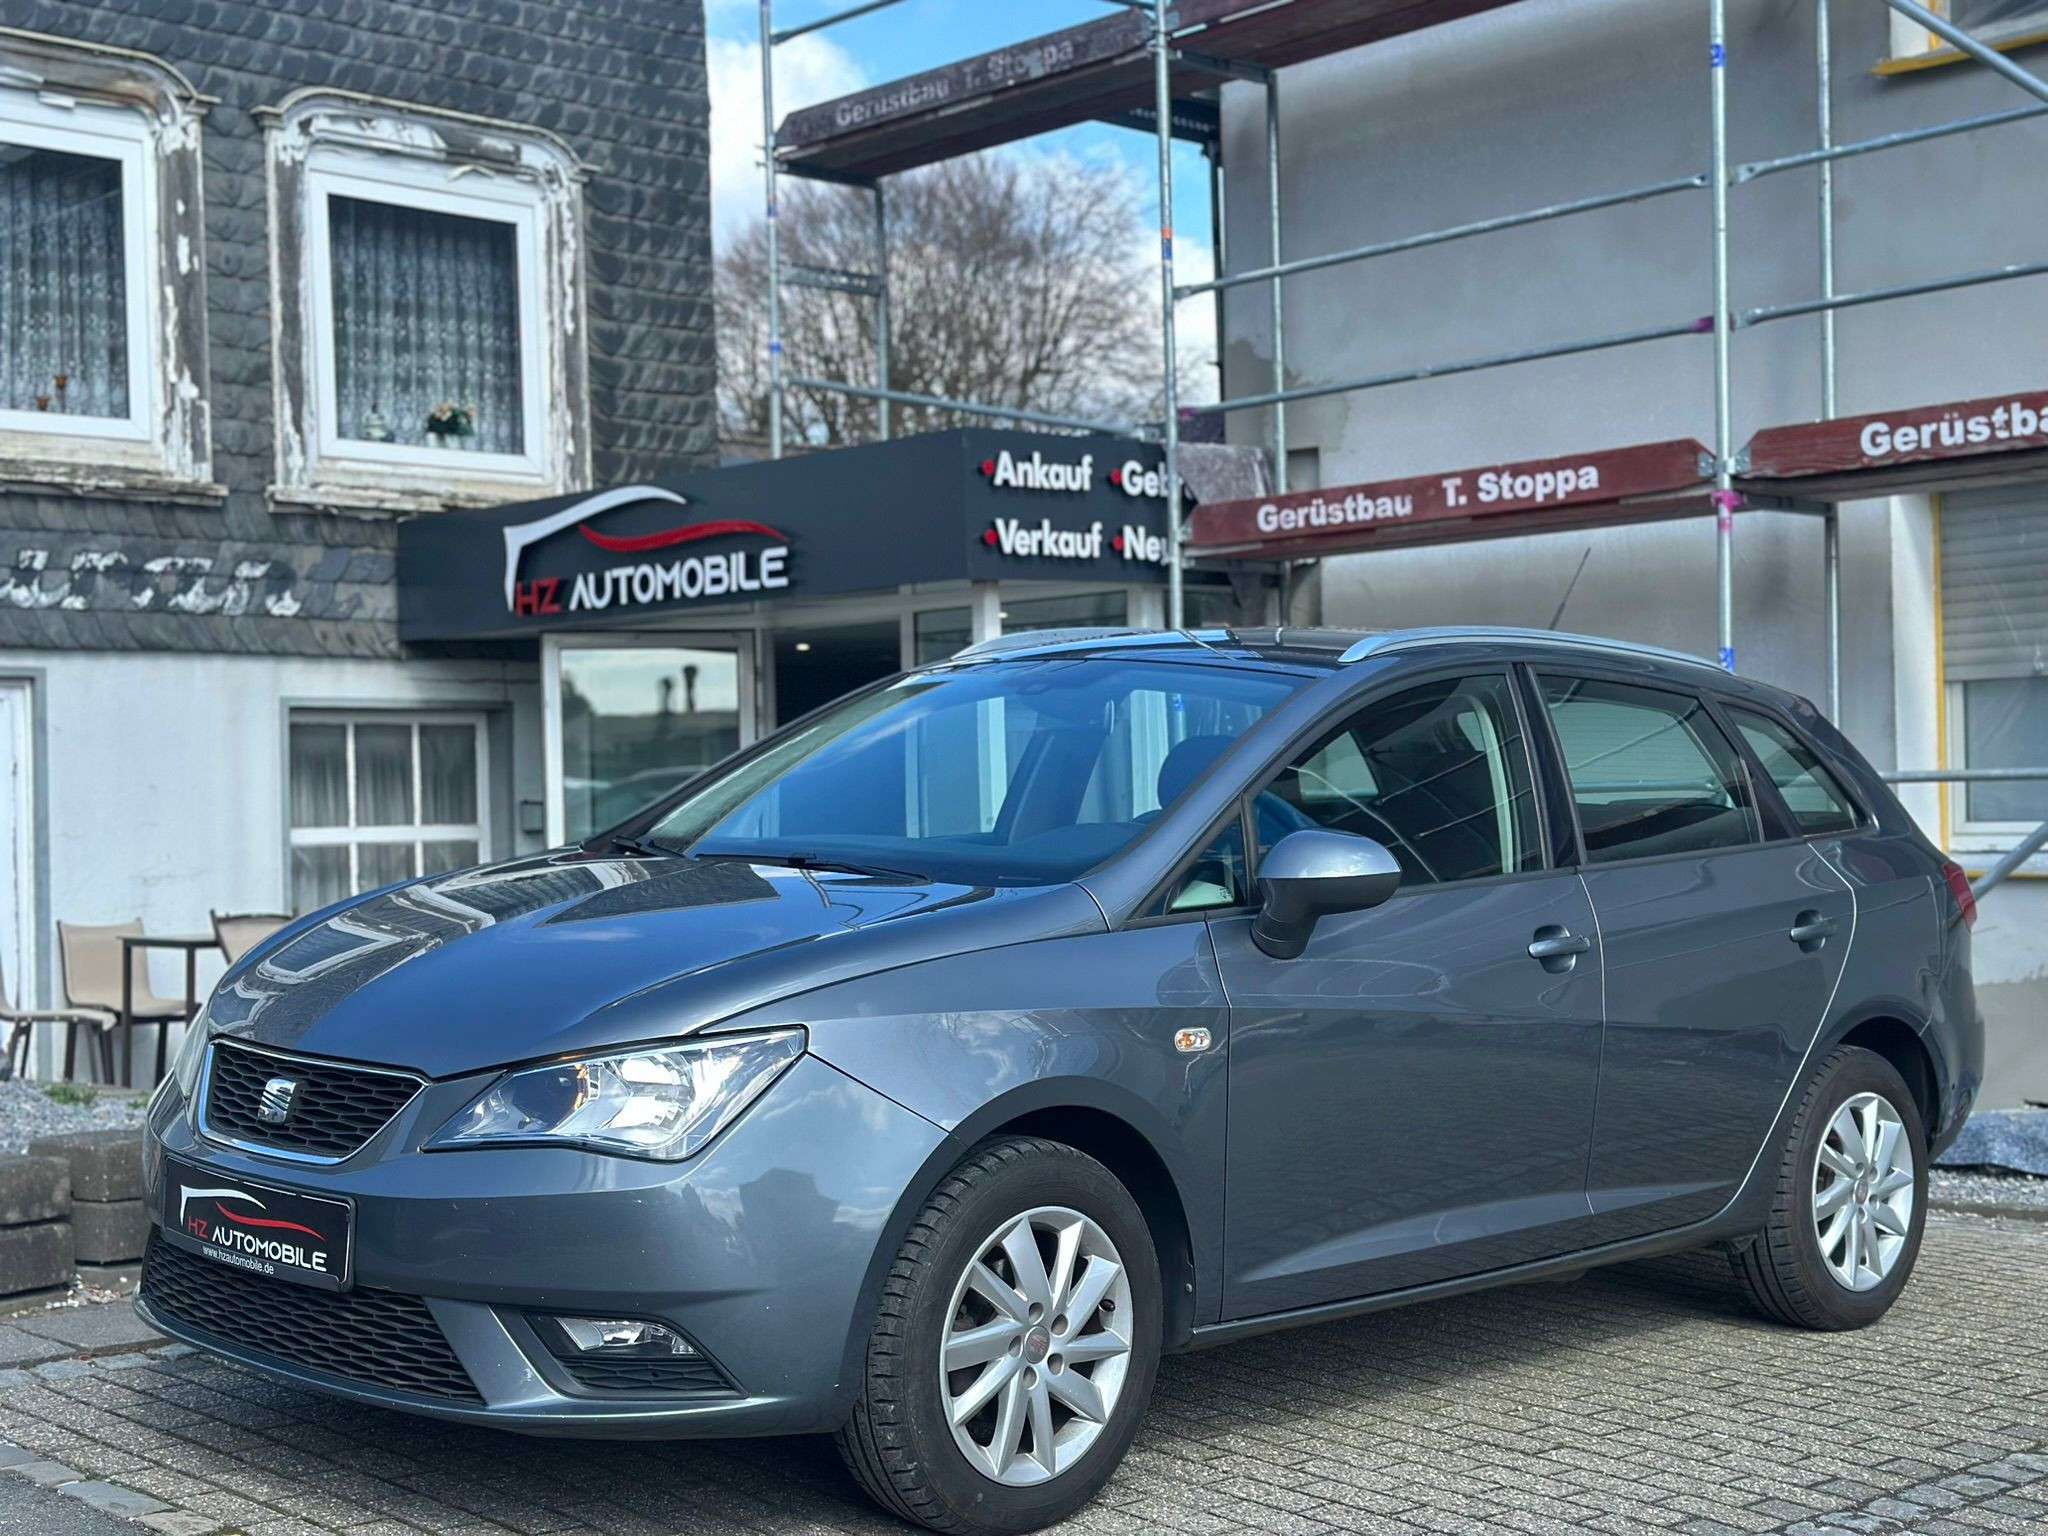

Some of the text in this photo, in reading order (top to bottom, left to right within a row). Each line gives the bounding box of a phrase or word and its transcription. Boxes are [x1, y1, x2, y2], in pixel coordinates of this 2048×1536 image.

[987, 40, 1075, 80] Stopa
[993, 450, 1093, 491] Ankauf
[1256, 464, 1599, 533] Gerüstbau T. Stoppa
[995, 517, 1103, 558] Verkauf
[515, 546, 789, 617] HZ AUTOMOBILE
[187, 1215, 328, 1272] HZ AUTOMOBILE
[202, 1245, 275, 1275] www.hzautomobile.de
